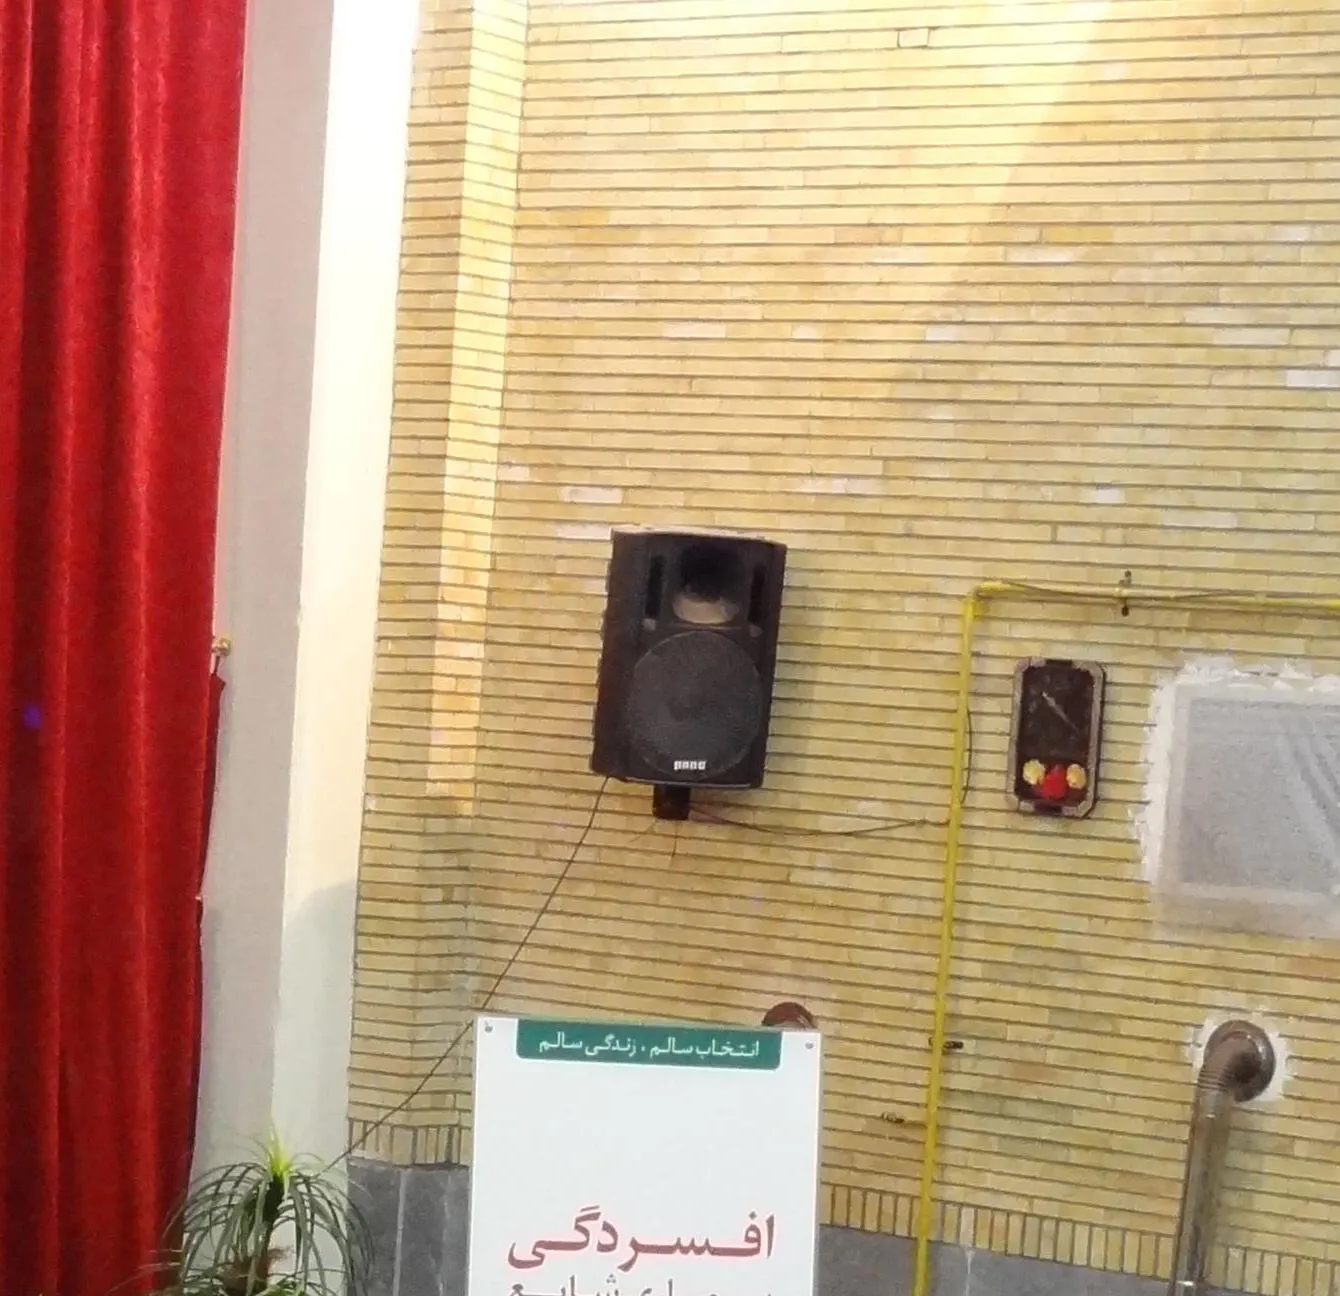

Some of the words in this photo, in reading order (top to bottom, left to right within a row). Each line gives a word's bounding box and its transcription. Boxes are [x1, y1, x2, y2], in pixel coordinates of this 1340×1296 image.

[538, 1030, 583, 1053] سالم
[584, 1032, 638, 1058] زندگی
[649, 1036, 693, 1058] سالم
[695, 1037, 760, 1060] انتخاب
[506, 1204, 775, 1273] افسردگی
